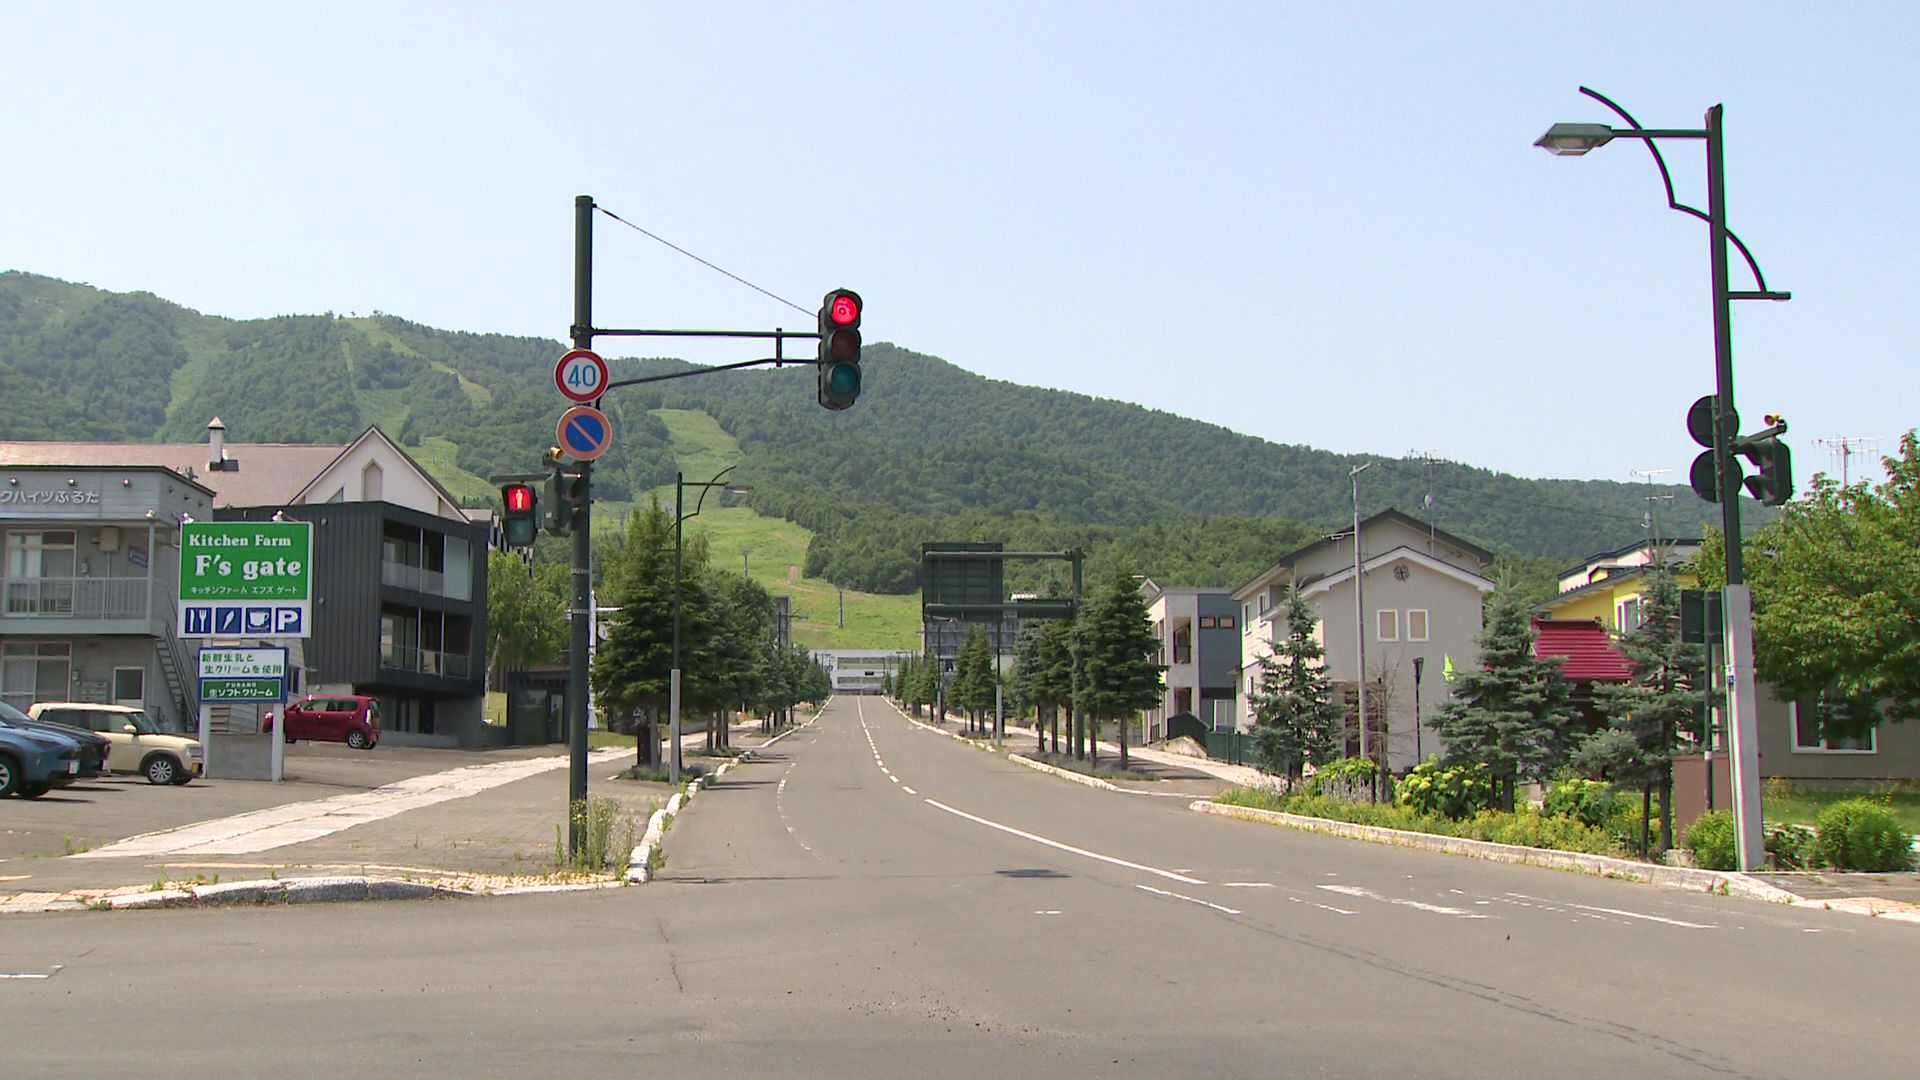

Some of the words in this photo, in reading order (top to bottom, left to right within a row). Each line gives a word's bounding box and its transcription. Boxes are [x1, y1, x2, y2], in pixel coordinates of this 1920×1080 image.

[568, 364, 596, 387] 40
[0, 490, 99, 504] クハイツふるた
[189, 534, 248, 546] Kitchen
[254, 534, 291, 546] Farm
[195, 554, 231, 576] F's
[242, 557, 301, 580] gate
[277, 609, 299, 630] P
[202, 653, 255, 663] 新鮮生乳と
[204, 664, 282, 675] 生クリームを使用
